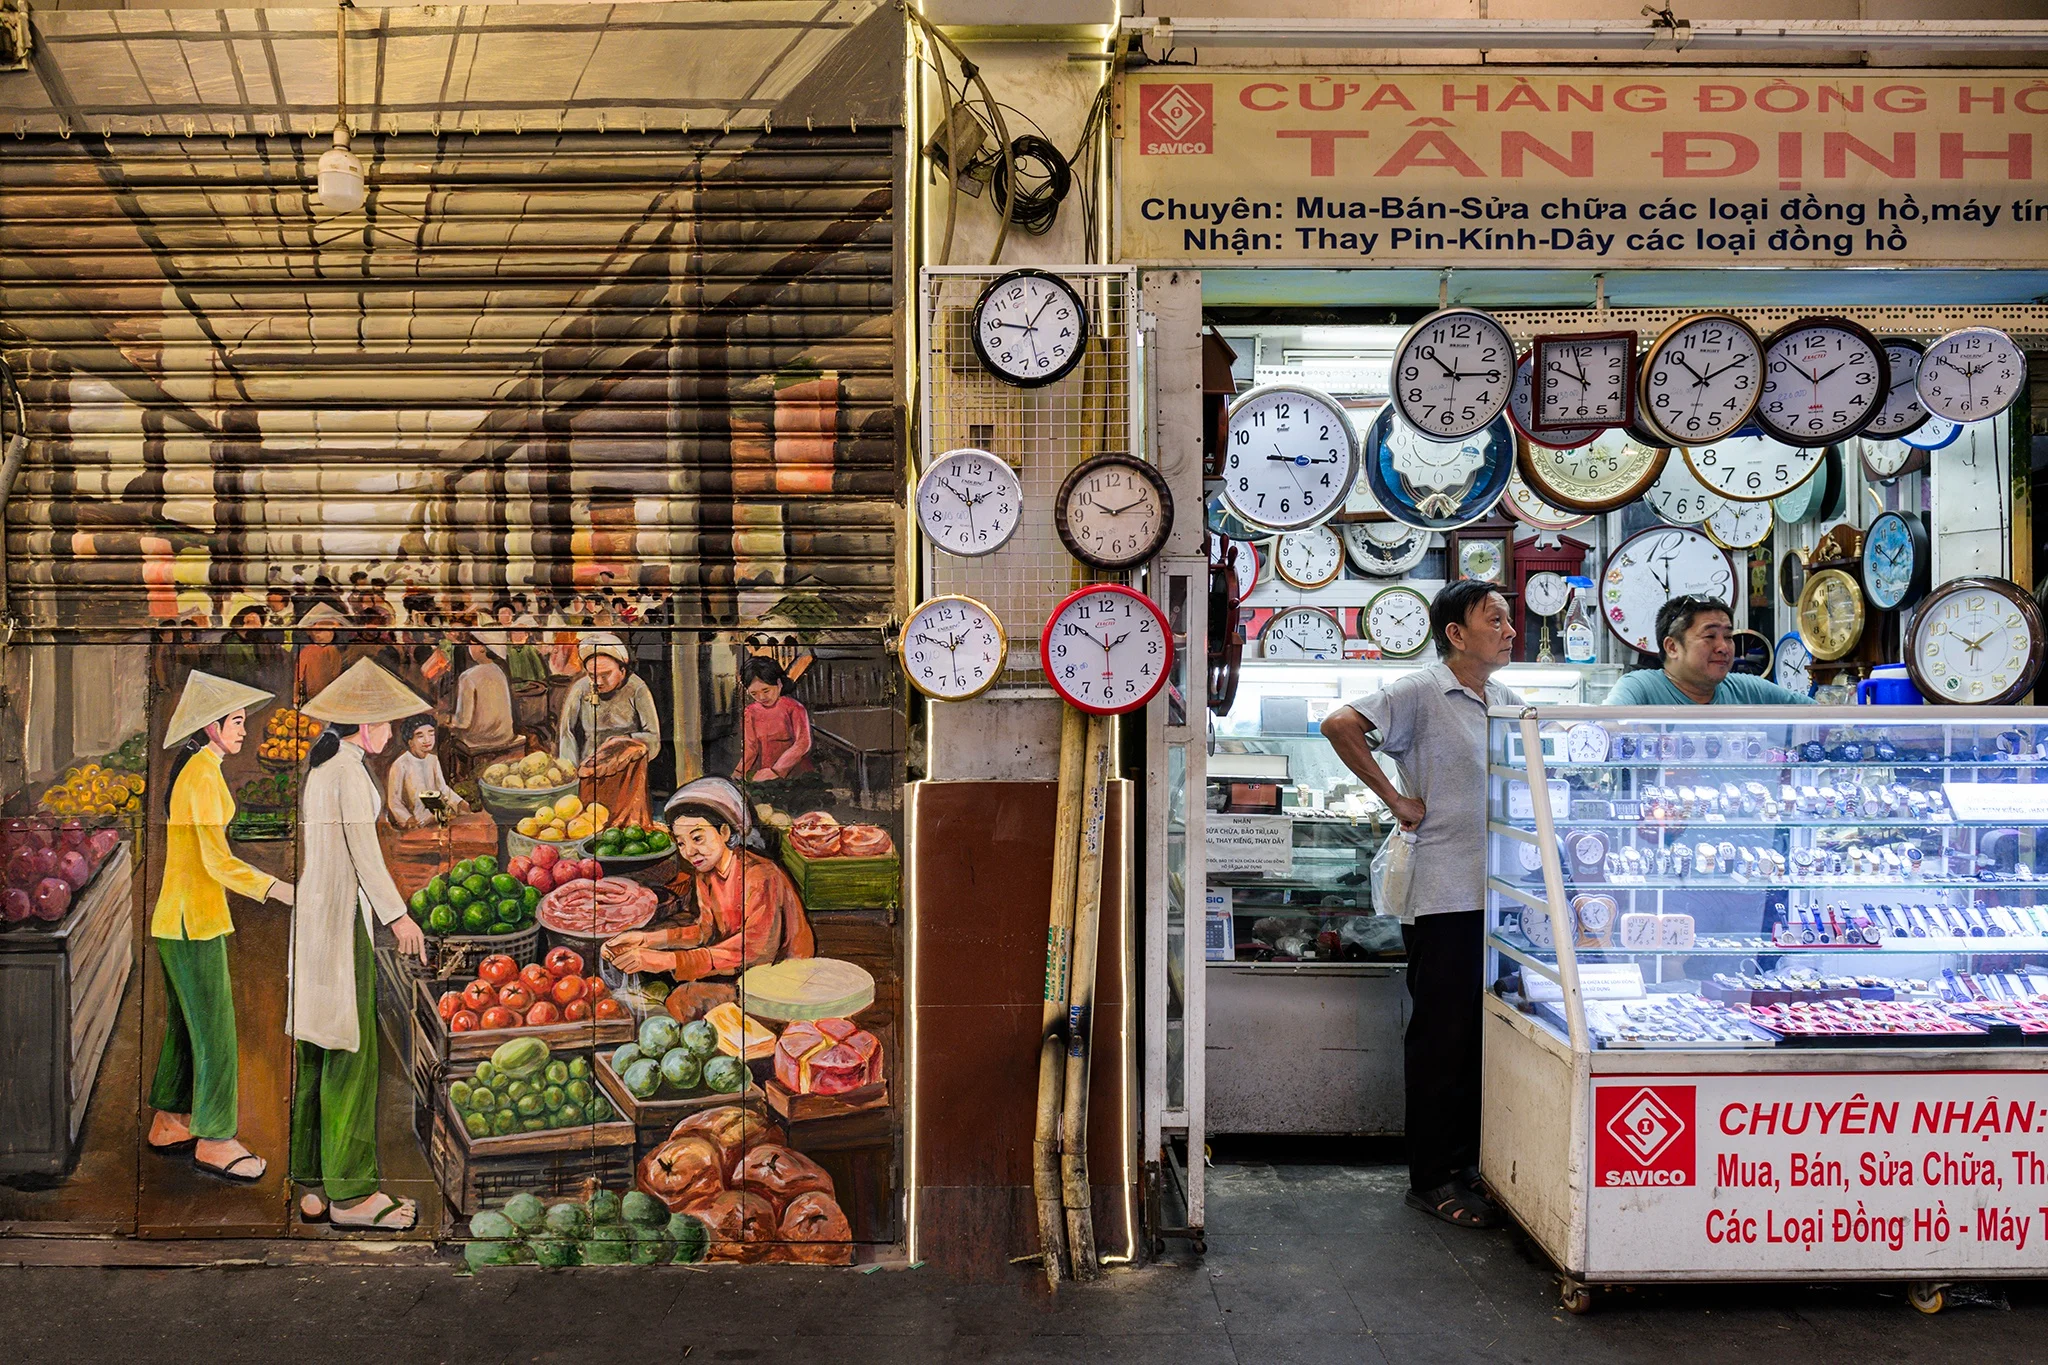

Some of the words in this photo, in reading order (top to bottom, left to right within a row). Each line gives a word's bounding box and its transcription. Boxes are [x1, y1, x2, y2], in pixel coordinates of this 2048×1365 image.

[1239, 76, 1416, 112] CỬA
[1442, 77, 1668, 113] HÀNG
[1693, 79, 1927, 114] ĐỒNG
[1147, 142, 1206, 155] SAVICO
[1276, 117, 1594, 178] TÂN
[1650, 131, 2033, 191] ĐỊNH
[1141, 197, 1283, 225] Chuyên:
[1296, 197, 1529, 220] Mua-Bán-Sửa
[1541, 198, 1627, 221] chữa
[1638, 198, 1697, 221] các
[1710, 198, 1768, 226] loại
[1780, 193, 1866, 226] đồng
[1878, 193, 2001, 227] hồ,máy
[1184, 228, 1282, 256] Nhận:
[1295, 228, 1378, 256] Thay
[1391, 228, 1614, 256] Pin-Kính-Dây
[1626, 228, 1685, 251] các
[1697, 228, 1756, 256] loại
[1768, 224, 1853, 256] đồng
[1866, 224, 1908, 251] hồ
[1007, 287, 1024, 300] 12
[1032, 286, 1037, 296] 1
[995, 300, 1006, 311] 11
[1056, 308, 1069, 320] 3
[987, 318, 1002, 331] 10
[1451, 324, 1471, 338] 12
[1060, 327, 1071, 338] 4
[1433, 330, 1445, 343] 11
[1477, 331, 1481, 345] 1
[1702, 329, 1722, 343] 12
[990, 337, 1002, 348] 9
[1684, 335, 1696, 349] 11
[1728, 337, 1733, 350] 1
[1805, 336, 1825, 348] 12
[1837, 339, 1841, 350] 1
[1053, 345, 1064, 356] 5
[1415, 346, 1435, 360] 10
[1482, 348, 1496, 362] 2
[1786, 344, 1797, 356] 11
[1001, 352, 1012, 363] 8
[1038, 357, 1050, 368] 6
[1665, 351, 1684, 365] 10
[1849, 353, 1864, 365] 2
[1019, 359, 1029, 370] 7
[1769, 362, 1787, 374] 10
[1405, 367, 1418, 381] 9
[1654, 372, 1667, 386] 9
[1856, 373, 1871, 384] 3
[1735, 376, 1748, 389] 3
[1408, 388, 1422, 402] 8
[1476, 391, 1490, 404] 4
[1656, 394, 1669, 407] 8
[1849, 395, 1864, 406] 4
[1723, 397, 1736, 410] 4
[1769, 401, 1783, 412] 8
[1275, 404, 1289, 419] 12
[1304, 409, 1309, 424] 1
[1422, 405, 1436, 418] 7
[1441, 411, 1454, 425] 6
[1462, 406, 1475, 420] 5
[1670, 410, 1683, 424] 7
[1832, 411, 1847, 422] 5
[1253, 412, 1265, 426] 11
[1687, 417, 1700, 430] 6
[1708, 412, 1721, 425] 5
[1787, 415, 1799, 426] 7
[1809, 418, 1823, 430] 6
[1235, 430, 1249, 445] 10
[1320, 426, 1328, 440] 2
[1230, 455, 1239, 468] 9
[1329, 449, 1337, 463] 3
[1703, 450, 1716, 465] 8
[1722, 468, 1735, 483] 7
[1775, 465, 1787, 480] 5
[1240, 478, 1248, 491] 8
[1320, 473, 1330, 487] 4
[1747, 472, 1761, 488] 6
[1257, 494, 1265, 508] 7
[1304, 491, 1313, 505] 5
[1281, 499, 1290, 512] 6
[1645, 531, 1684, 563] 12
[1098, 600, 1113, 612] 12
[1125, 605, 1131, 617] 1
[1079, 607, 1090, 619] 11
[1064, 624, 1077, 636] 10
[1140, 620, 1149, 632] 2
[1057, 645, 1066, 657] 9
[1148, 642, 1157, 653] 3
[1065, 666, 1075, 678] 8
[1141, 663, 1150, 675] 4
[1082, 682, 1090, 693] 7
[1104, 687, 1113, 698] 6
[1126, 680, 1135, 692] 5
[1719, 1093, 1900, 1136] CHUYÊN
[1911, 1096, 2048, 1142] NHẬN:
[1605, 1170, 1686, 1186] SAVICO
[1717, 1152, 1781, 1193] Mua,
[1790, 1151, 1850, 1192] Bán,
[1860, 1150, 1913, 1187] Sửa
[1923, 1151, 2004, 1192] Chữa,
[2012, 1151, 2048, 1186] Th
[1706, 1208, 1758, 1245] Các
[1766, 1208, 1824, 1251] Loại
[1832, 1200, 1904, 1251] Đồng
[1914, 1200, 1950, 1243] Hồ
[1976, 1206, 2030, 1250] Máy
